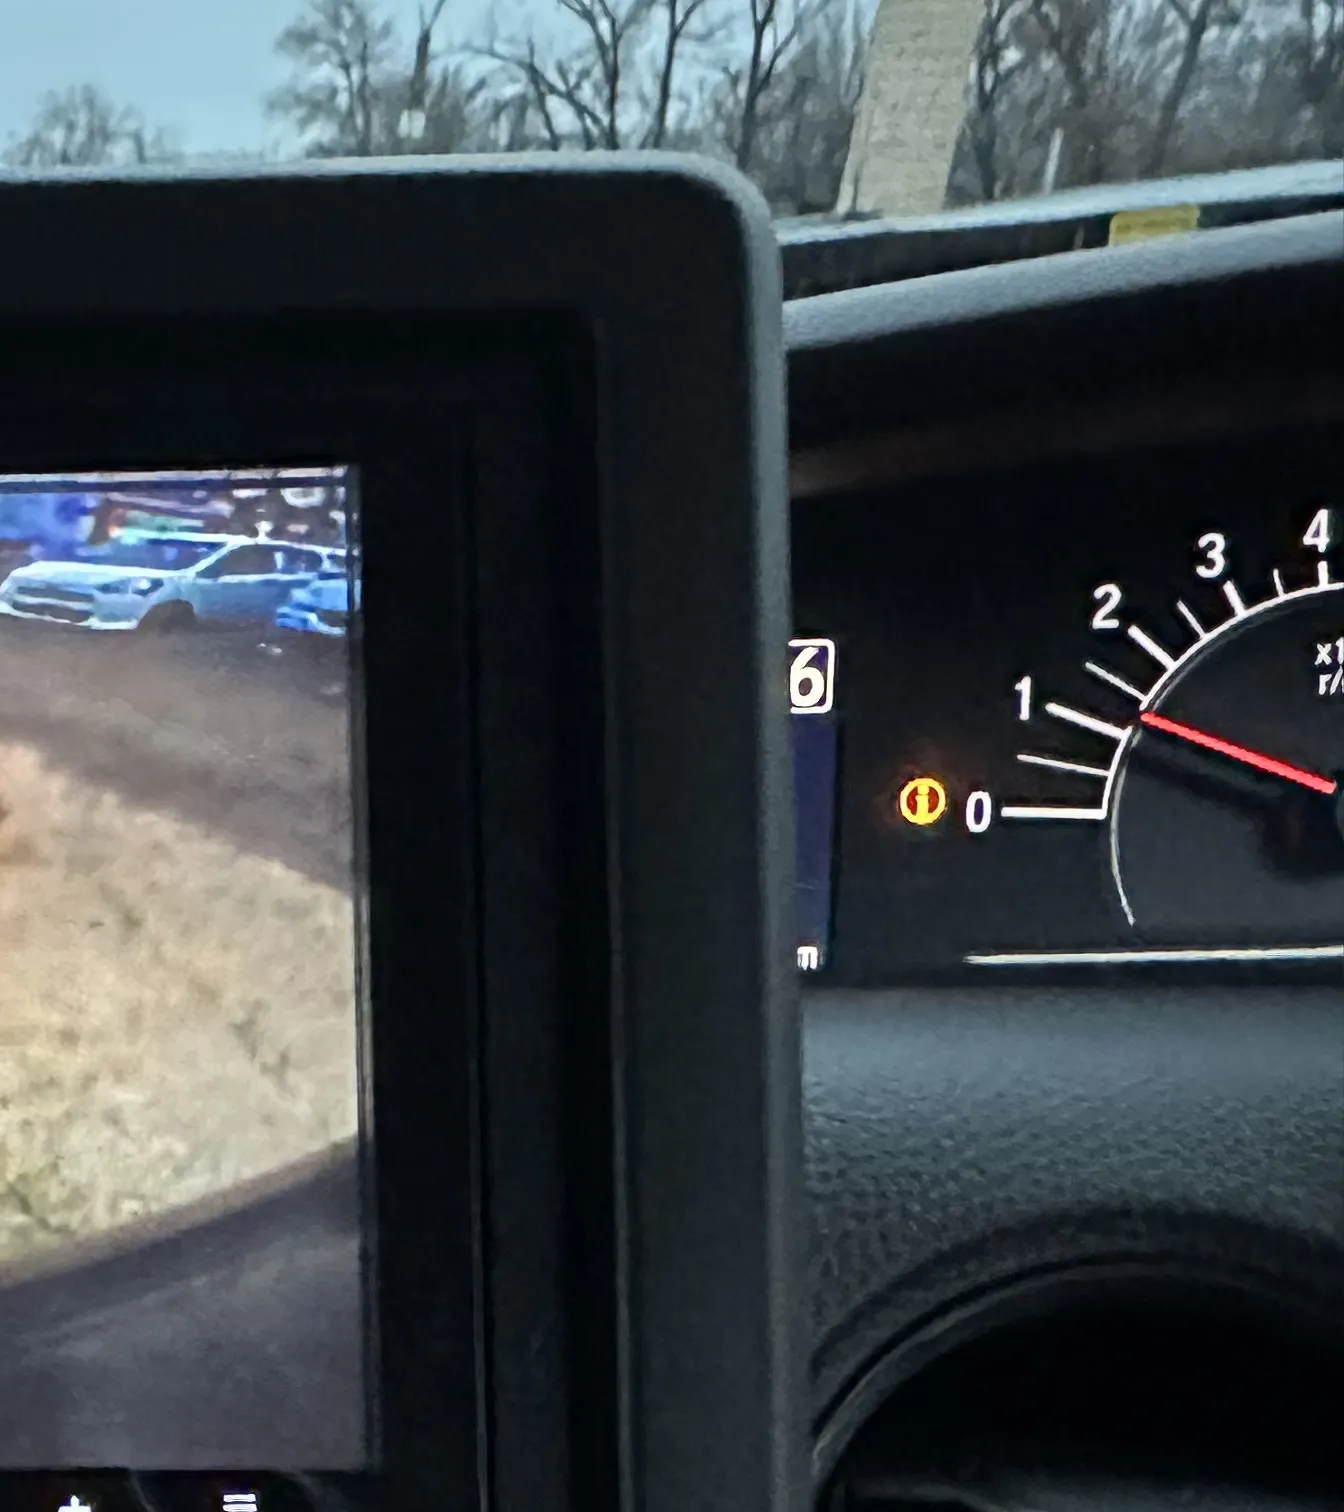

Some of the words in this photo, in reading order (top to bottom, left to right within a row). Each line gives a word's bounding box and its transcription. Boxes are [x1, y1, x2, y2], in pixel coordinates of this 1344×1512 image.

[1302, 508, 1330, 553] 4
[1196, 532, 1226, 579] 3
[1092, 583, 1122, 630] 2
[1014, 675, 1032, 721] 1
[965, 790, 992, 833] 0
